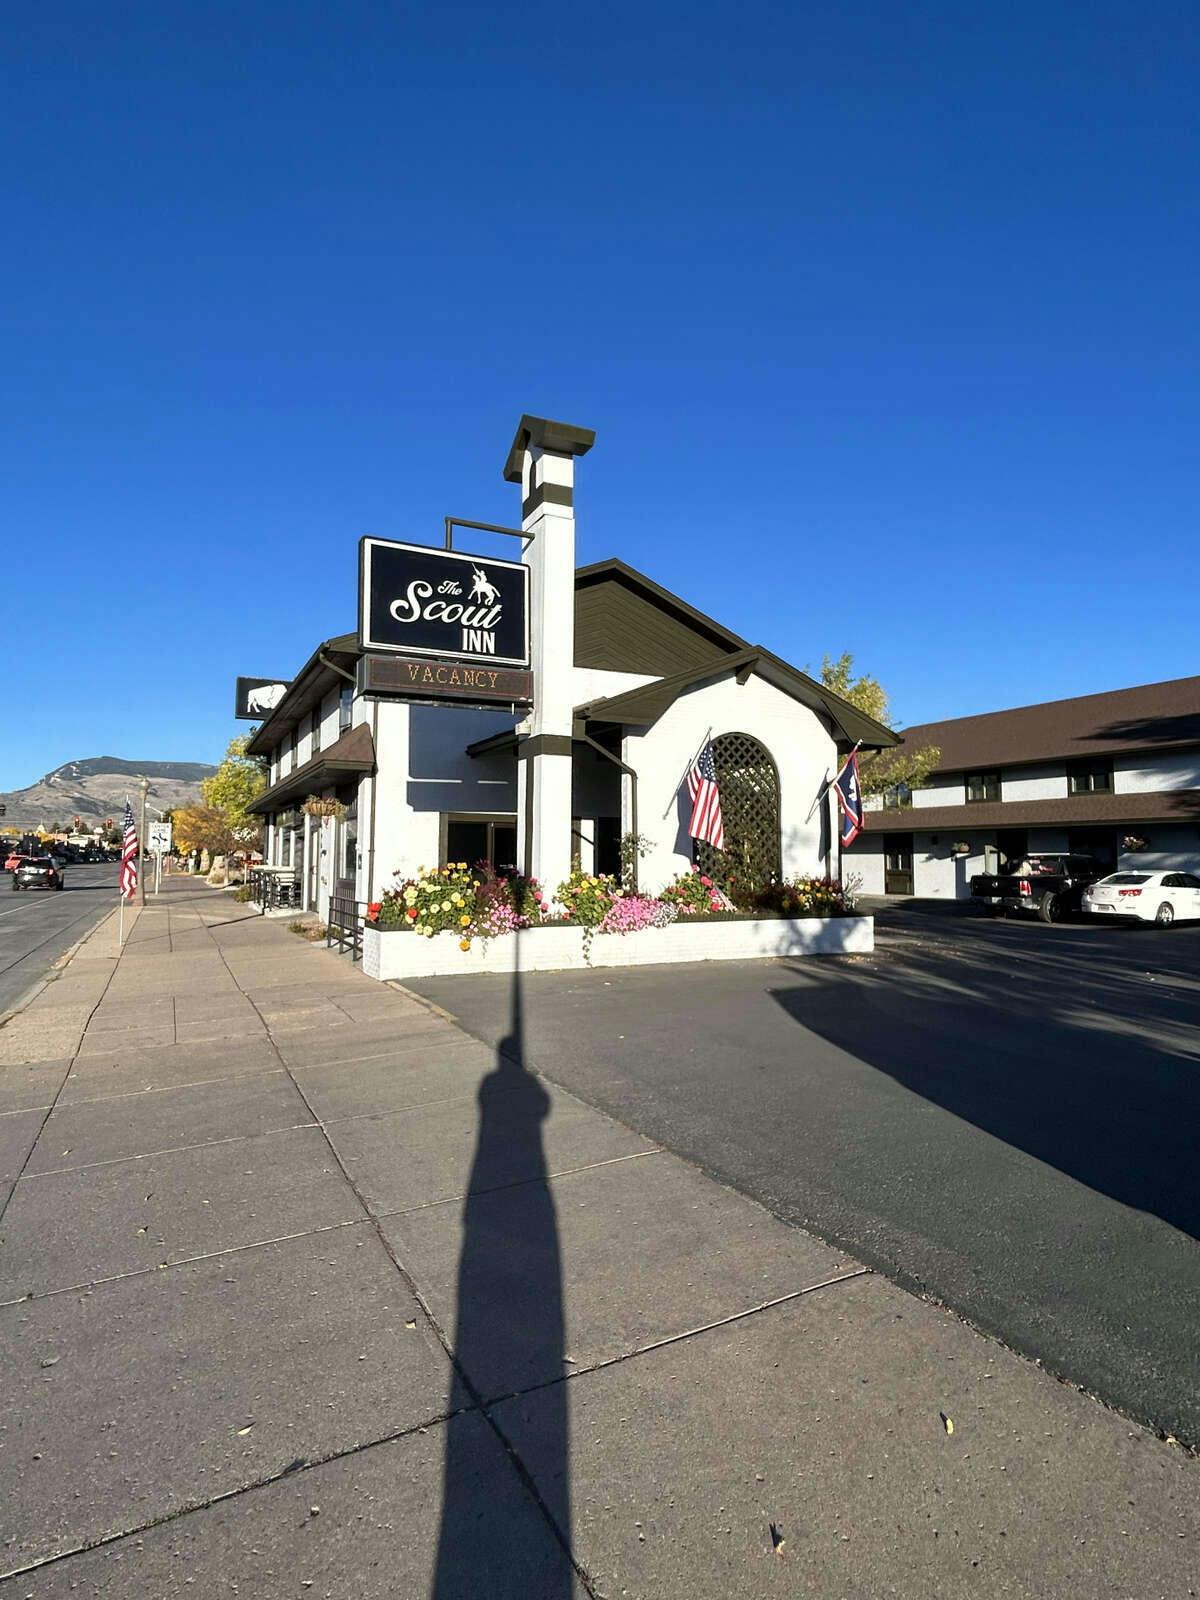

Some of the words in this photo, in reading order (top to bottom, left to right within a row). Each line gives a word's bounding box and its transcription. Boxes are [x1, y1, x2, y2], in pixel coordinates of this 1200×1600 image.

[437, 580, 463, 596] The
[389, 580, 503, 629] Scout
[462, 628, 496, 654] INN
[407, 664, 499, 688] VACANCY
